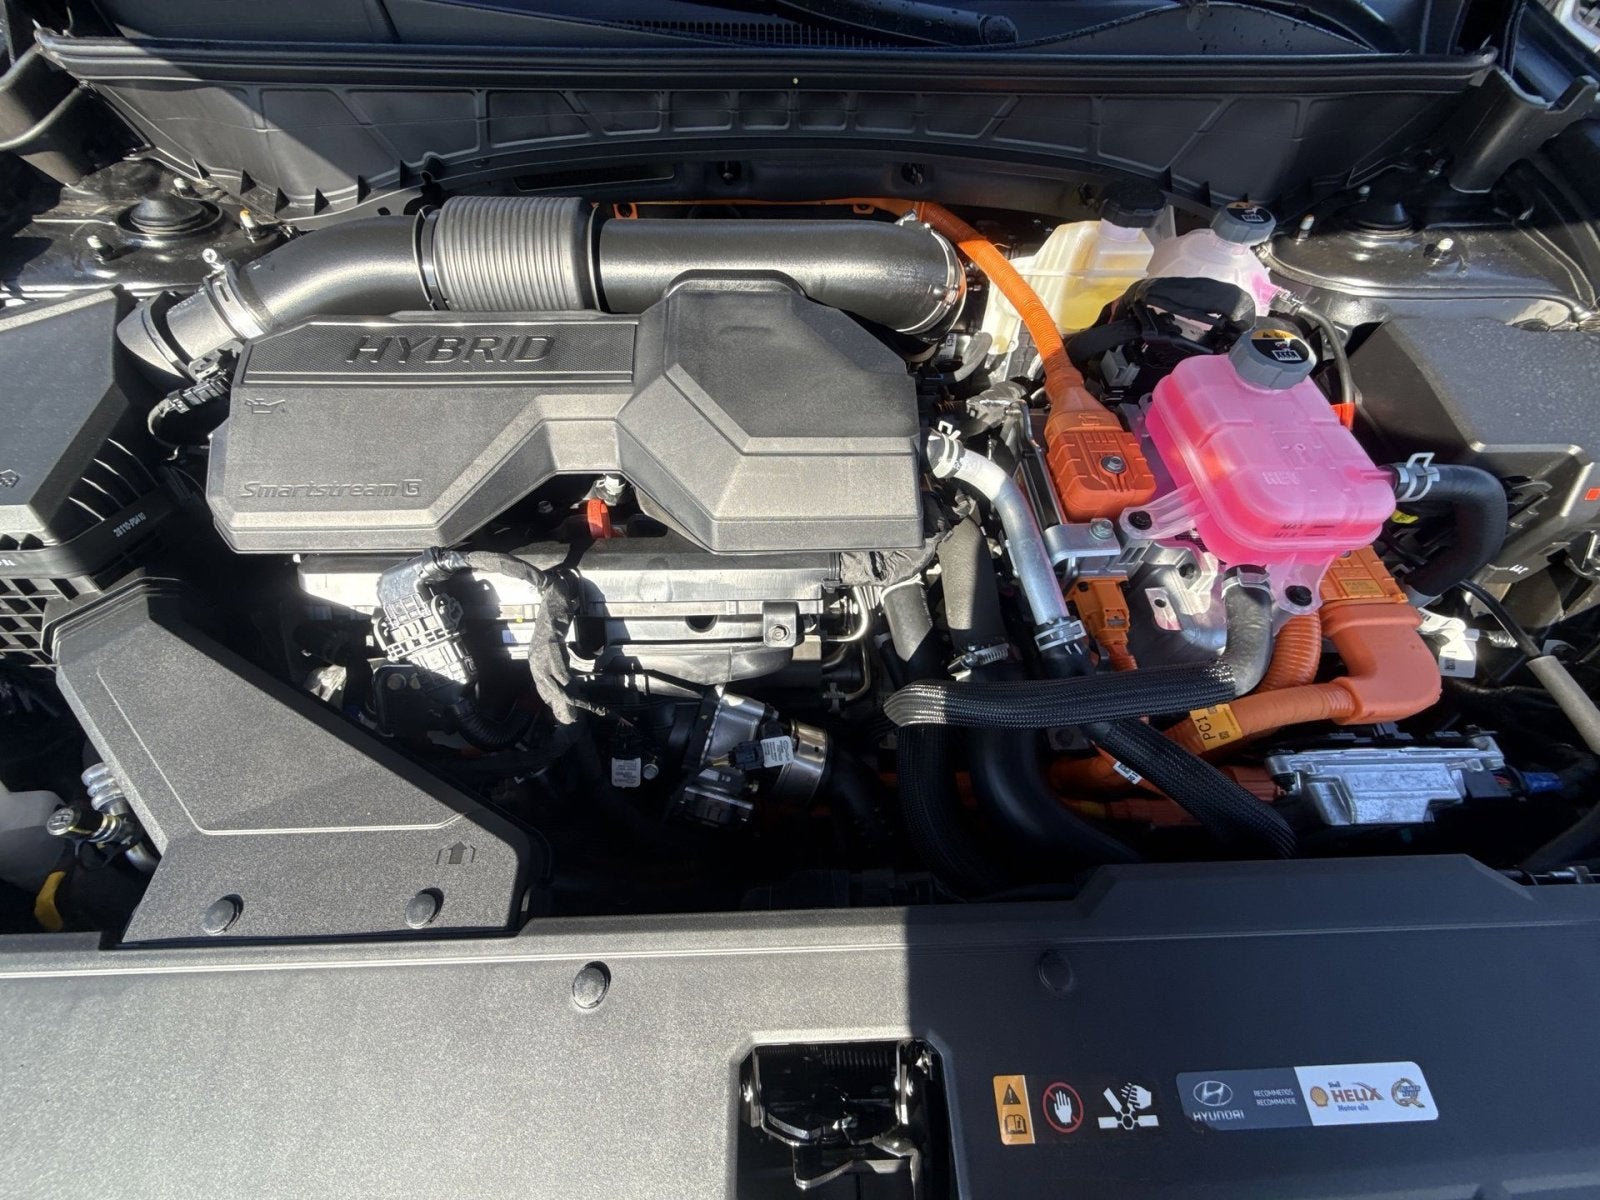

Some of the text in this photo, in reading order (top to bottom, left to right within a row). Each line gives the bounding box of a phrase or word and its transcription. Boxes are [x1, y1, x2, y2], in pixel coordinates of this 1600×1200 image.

[346, 335, 555, 363] HYBRID
[240, 480, 398, 498] Smartstream
[1195, 715, 1216, 741] PC1
[1331, 1086, 1384, 1103] HELIX
[1192, 1109, 1246, 1122] HYUNDAI
